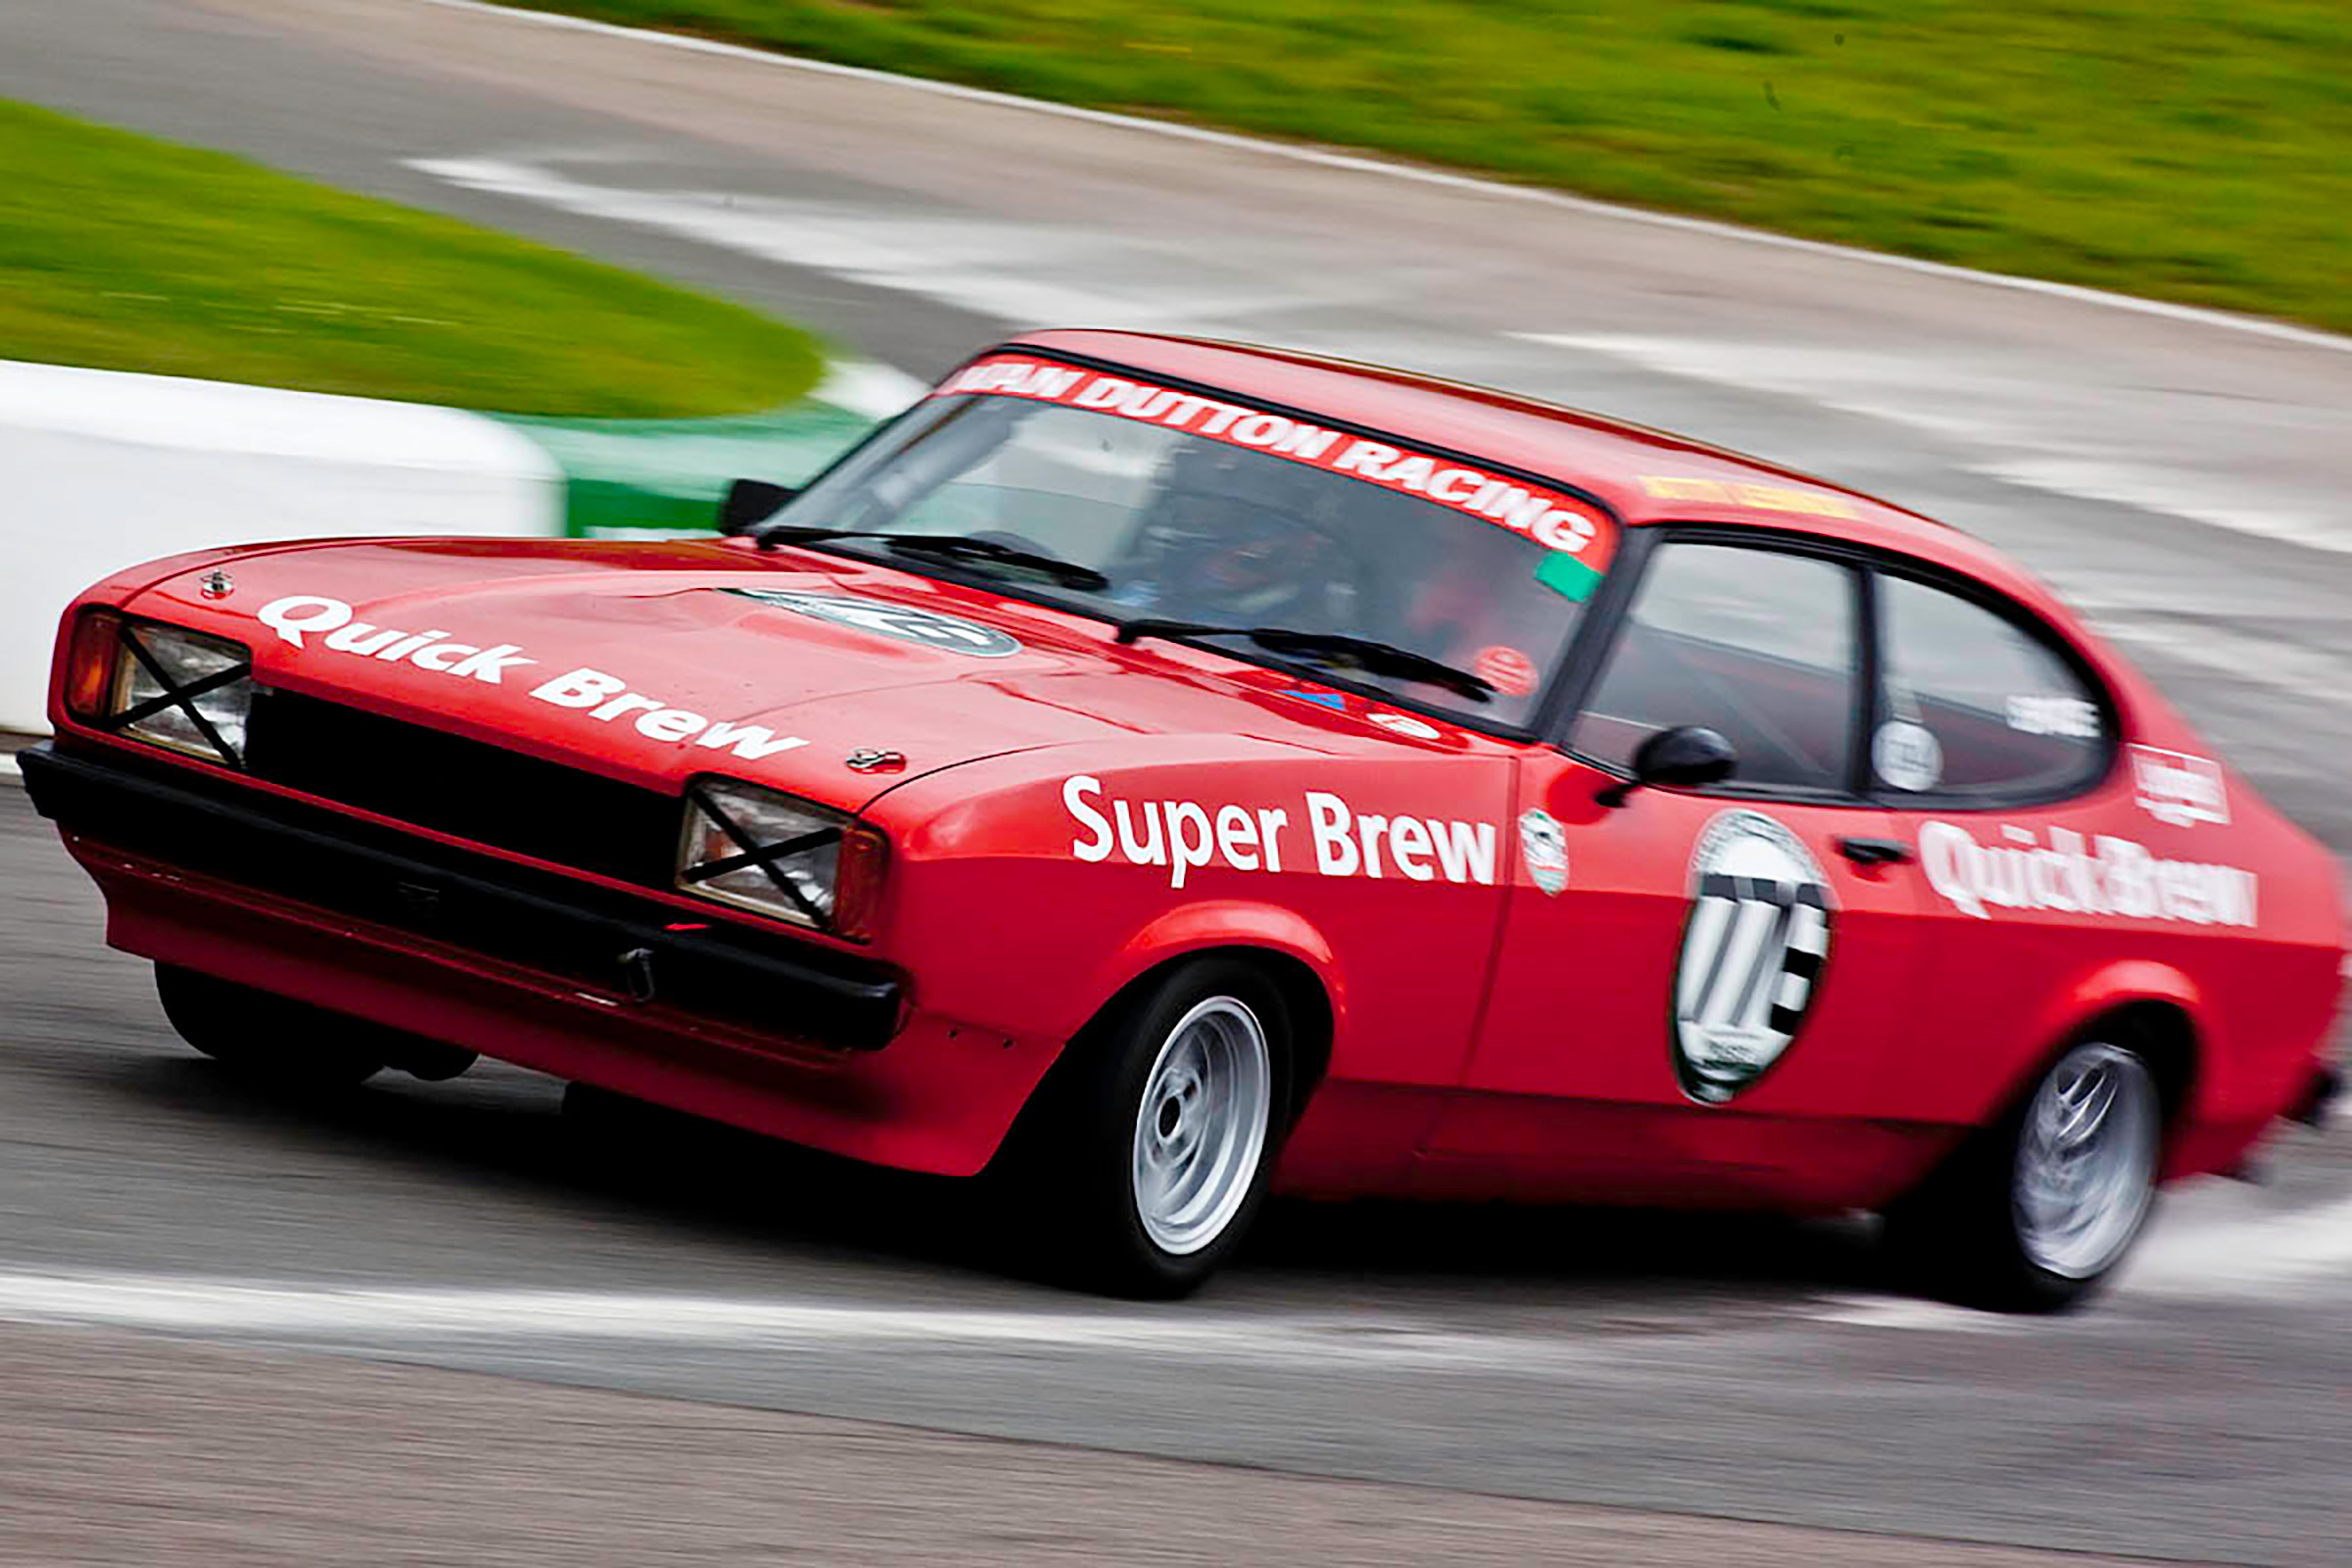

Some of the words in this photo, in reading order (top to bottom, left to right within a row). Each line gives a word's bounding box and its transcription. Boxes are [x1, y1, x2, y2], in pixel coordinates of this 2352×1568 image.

[1072, 376, 1341, 459] DUTTON
[1333, 440, 1595, 553] RACING
[257, 595, 537, 685] Quick
[529, 667, 809, 760] Brew
[1063, 775, 1287, 889] Super
[1305, 792, 1495, 885] Brew
